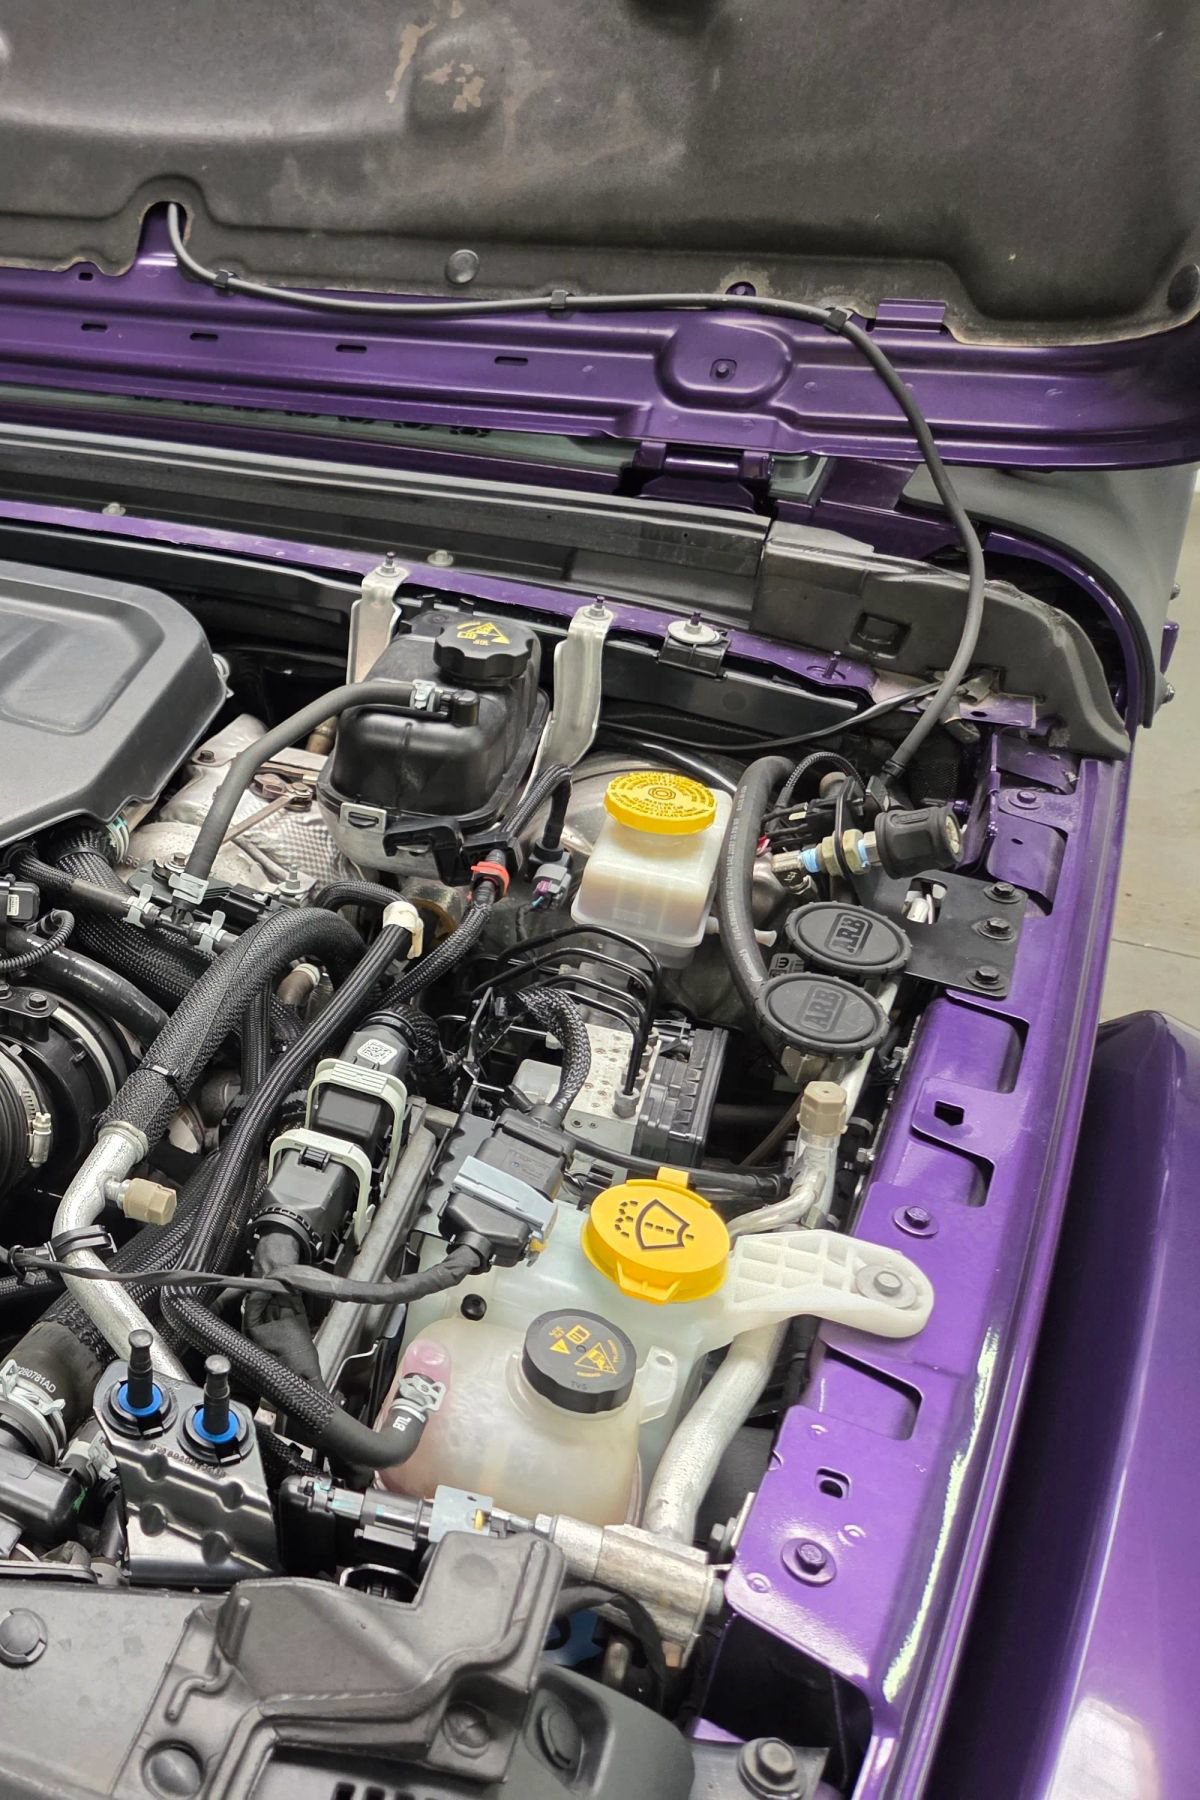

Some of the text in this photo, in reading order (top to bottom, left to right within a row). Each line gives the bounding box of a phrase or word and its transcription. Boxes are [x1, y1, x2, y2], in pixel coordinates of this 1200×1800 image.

[831, 917, 865, 953] ARB
[803, 989, 839, 1030] ARB
[392, 1415, 412, 1432] BTL
